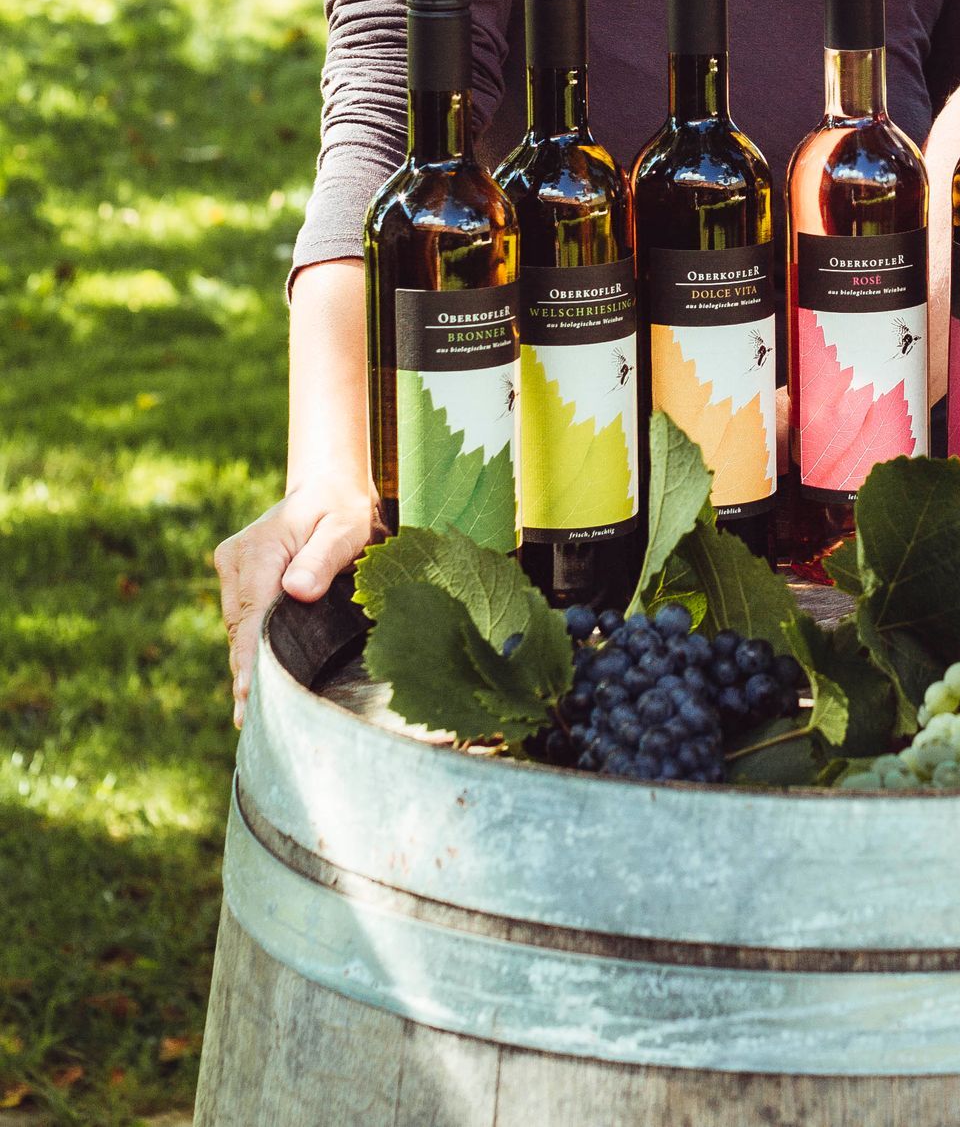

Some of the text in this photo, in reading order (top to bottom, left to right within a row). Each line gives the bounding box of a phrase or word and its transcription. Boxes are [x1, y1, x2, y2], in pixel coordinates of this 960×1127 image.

[829, 254, 905, 268] OBERKOFLER
[687, 265, 760, 281] OBERKOFLER
[852, 275, 882, 286] ROSÉ
[549, 282, 622, 299] OBERKOFLER
[691, 285, 757, 299] DOLCE VITA
[840, 289, 881, 297] biologischem
[883, 286, 907, 294] Weinbau
[529, 298, 632, 318] WELSCHRIESLING
[698, 301, 739, 310] biologischem
[740, 298, 761, 306] Weinbau
[437, 305, 511, 324] OBERKOFLER
[559, 319, 601, 329] biologischem
[602, 316, 624, 324] Weinbau
[447, 327, 506, 343] BRONNER
[450, 344, 492, 354] biologischem
[568, 531, 590, 540] frisch,
